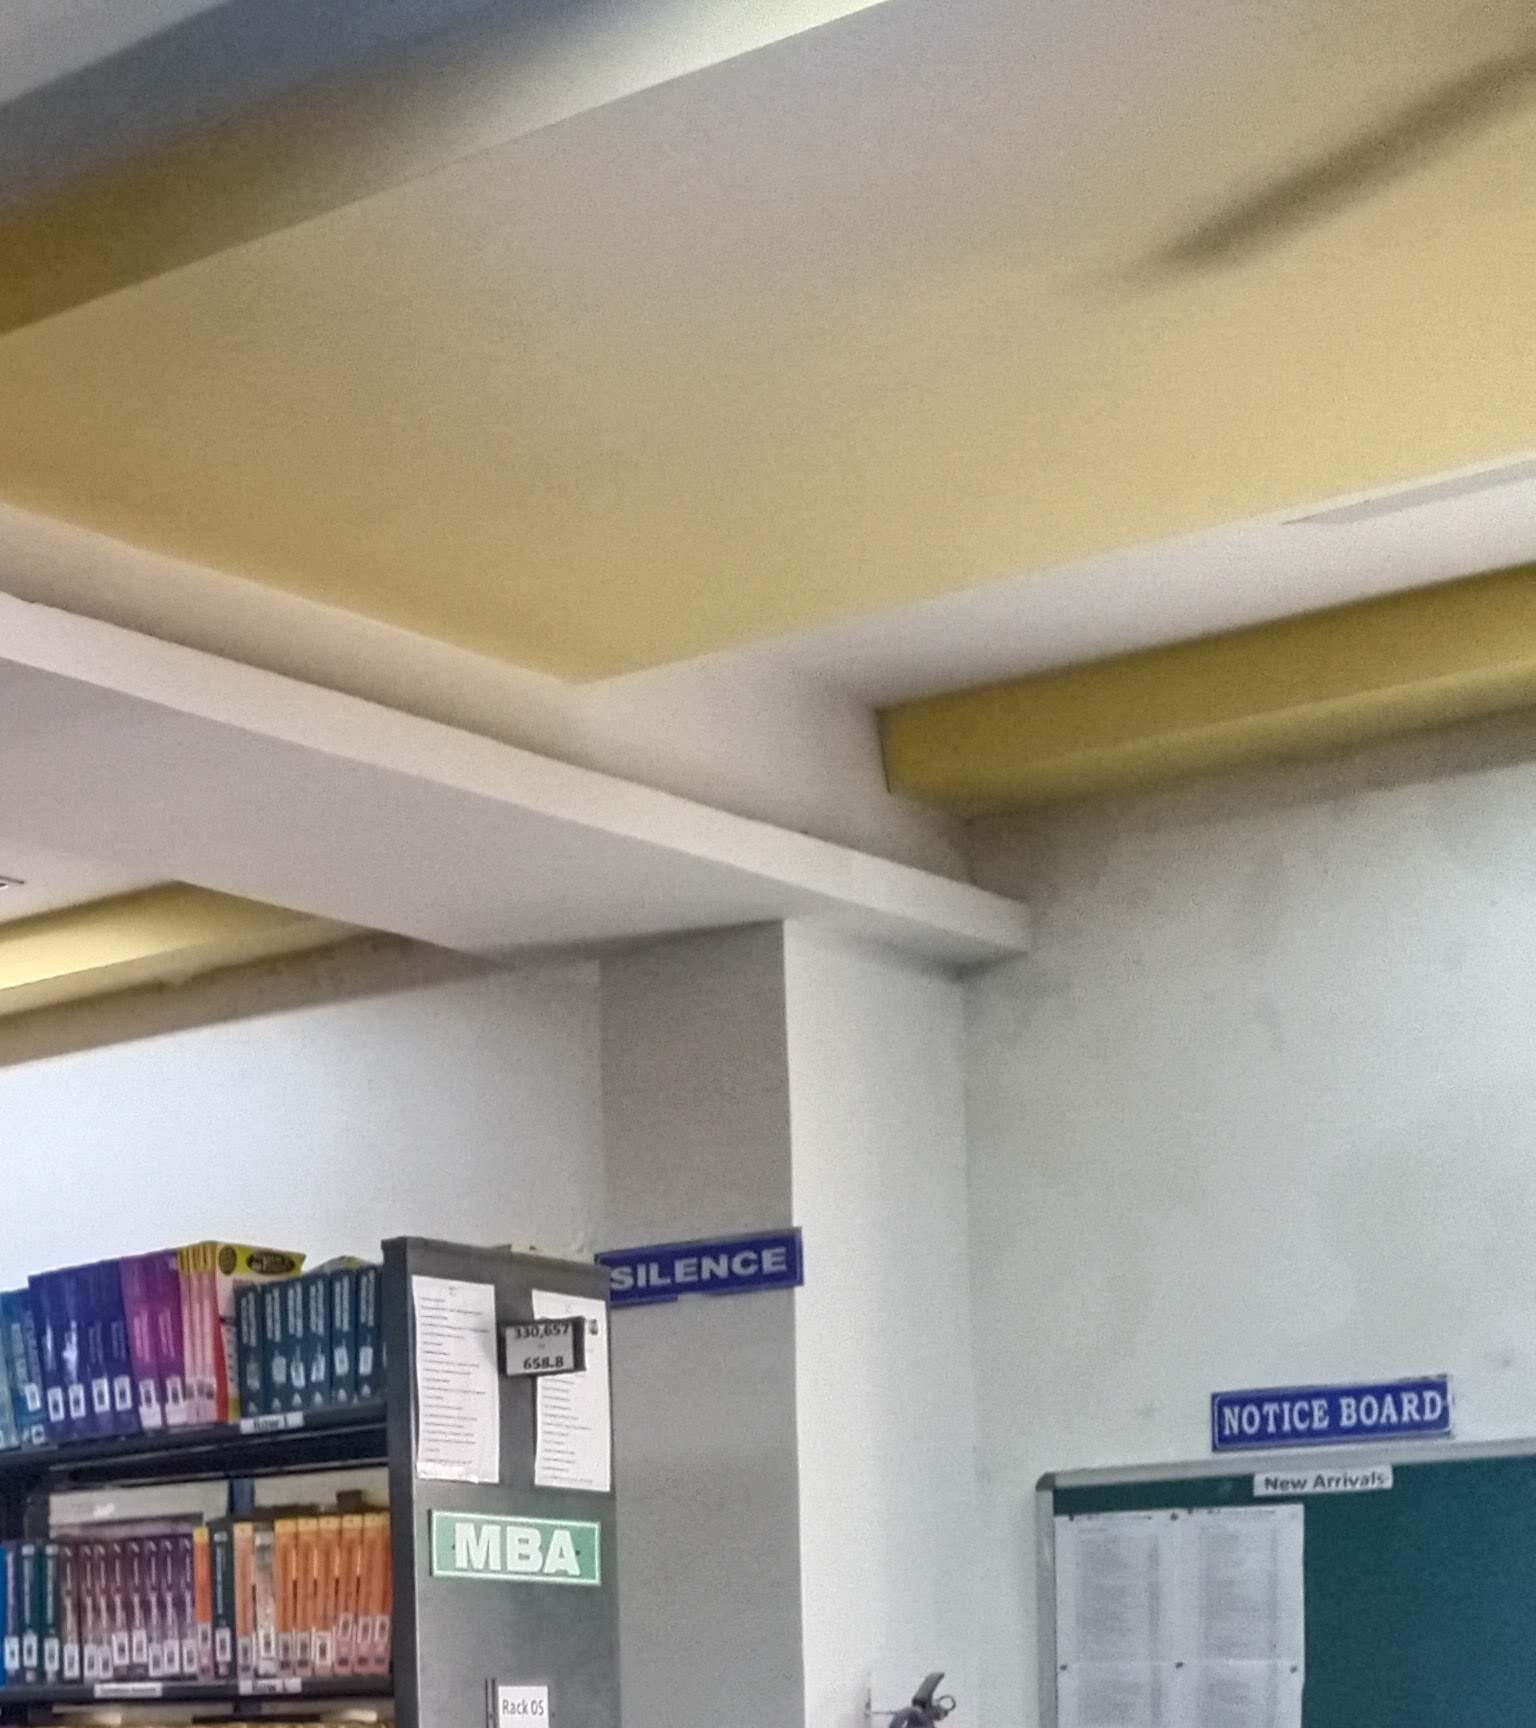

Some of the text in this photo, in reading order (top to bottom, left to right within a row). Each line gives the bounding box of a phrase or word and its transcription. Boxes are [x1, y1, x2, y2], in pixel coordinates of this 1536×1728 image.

[610, 1247, 787, 1291] SILENCE
[1223, 1390, 1442, 1436] NOTICE BOARD
[1264, 1477, 1307, 1491] New
[454, 1523, 581, 1577] MBA
[502, 1699, 545, 1717] Rack 05
